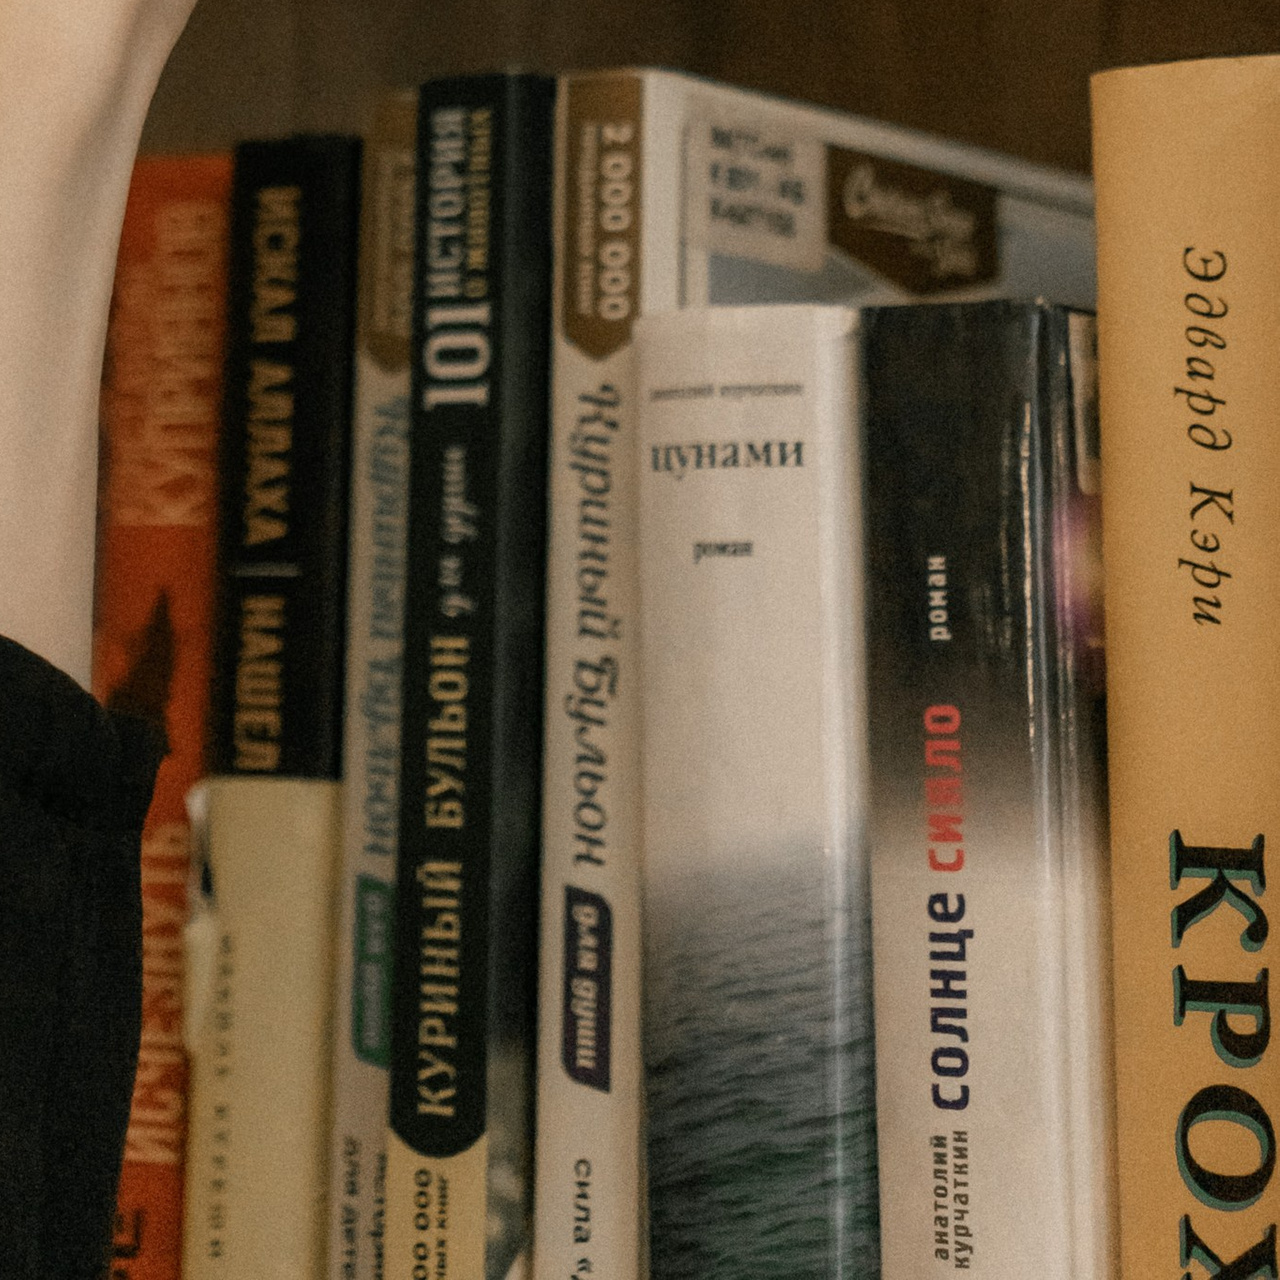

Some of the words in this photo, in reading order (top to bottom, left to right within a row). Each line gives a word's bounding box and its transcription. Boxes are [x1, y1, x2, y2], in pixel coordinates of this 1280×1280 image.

[599, 153, 633, 231] 000
[252, 187, 302, 342] ИСКАЛ
[600, 242, 634, 321] 000
[423, 302, 491, 411] 101
[1174, 246, 1232, 451] Эдвард
[243, 360, 295, 546] АЛЛАХА
[567, 385, 622, 640] Куриный
[650, 441, 804, 481] цунами
[927, 554, 951, 642] роман
[1178, 481, 1235, 626] Кэри
[234, 596, 285, 770] НАШЕЛ
[426, 636, 470, 831] БУЛЬОН
[566, 656, 619, 866] Бульон
[415, 862, 464, 1118] КУРИНЫЙ
[572, 904, 600, 971] для
[572, 978, 600, 1071] души
[574, 1158, 595, 1245] сила
[929, 1135, 949, 1260] анатолий
[952, 1130, 974, 1269] курчаткин
